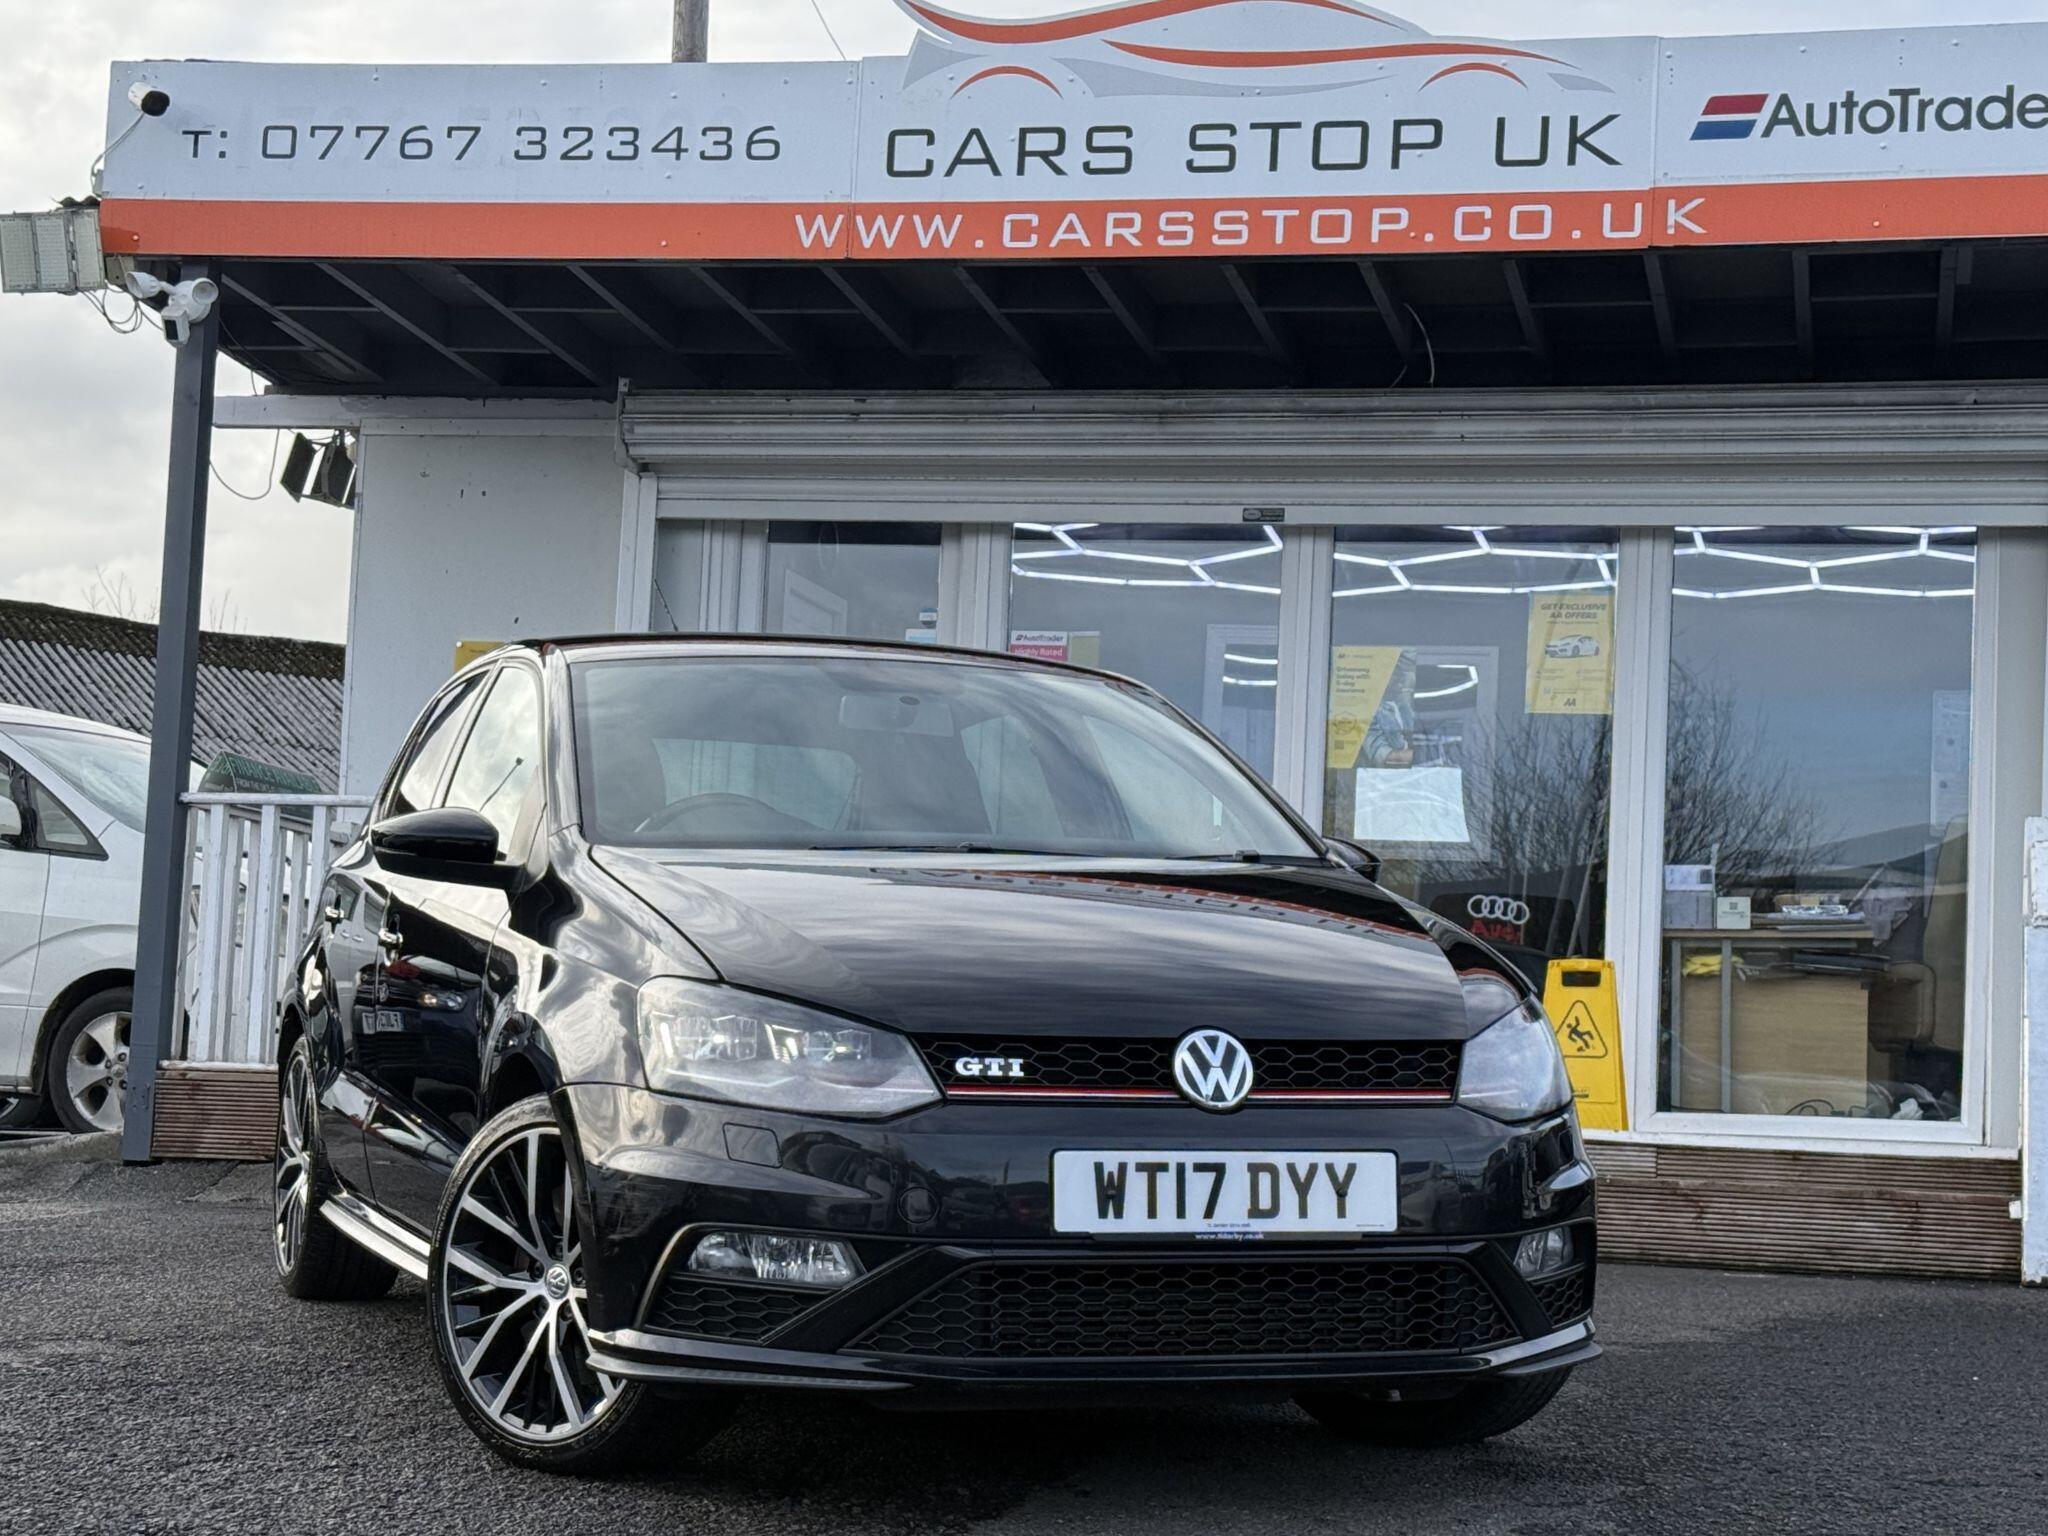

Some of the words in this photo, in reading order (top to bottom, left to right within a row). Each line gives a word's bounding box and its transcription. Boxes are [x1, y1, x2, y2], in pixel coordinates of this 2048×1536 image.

[182, 130, 228, 160] T:
[261, 124, 482, 161] 07767
[512, 124, 782, 161] 323436
[886, 125, 1134, 178] CARS
[1185, 118, 1443, 174] STOP
[1494, 113, 1623, 167] UK
[795, 198, 1708, 249] WWW.CARSSTOP.CO.UK
[955, 1057, 1025, 1077] GTI
[1093, 1161, 1227, 1219] WT17
[1247, 1162, 1358, 1219] DYY
